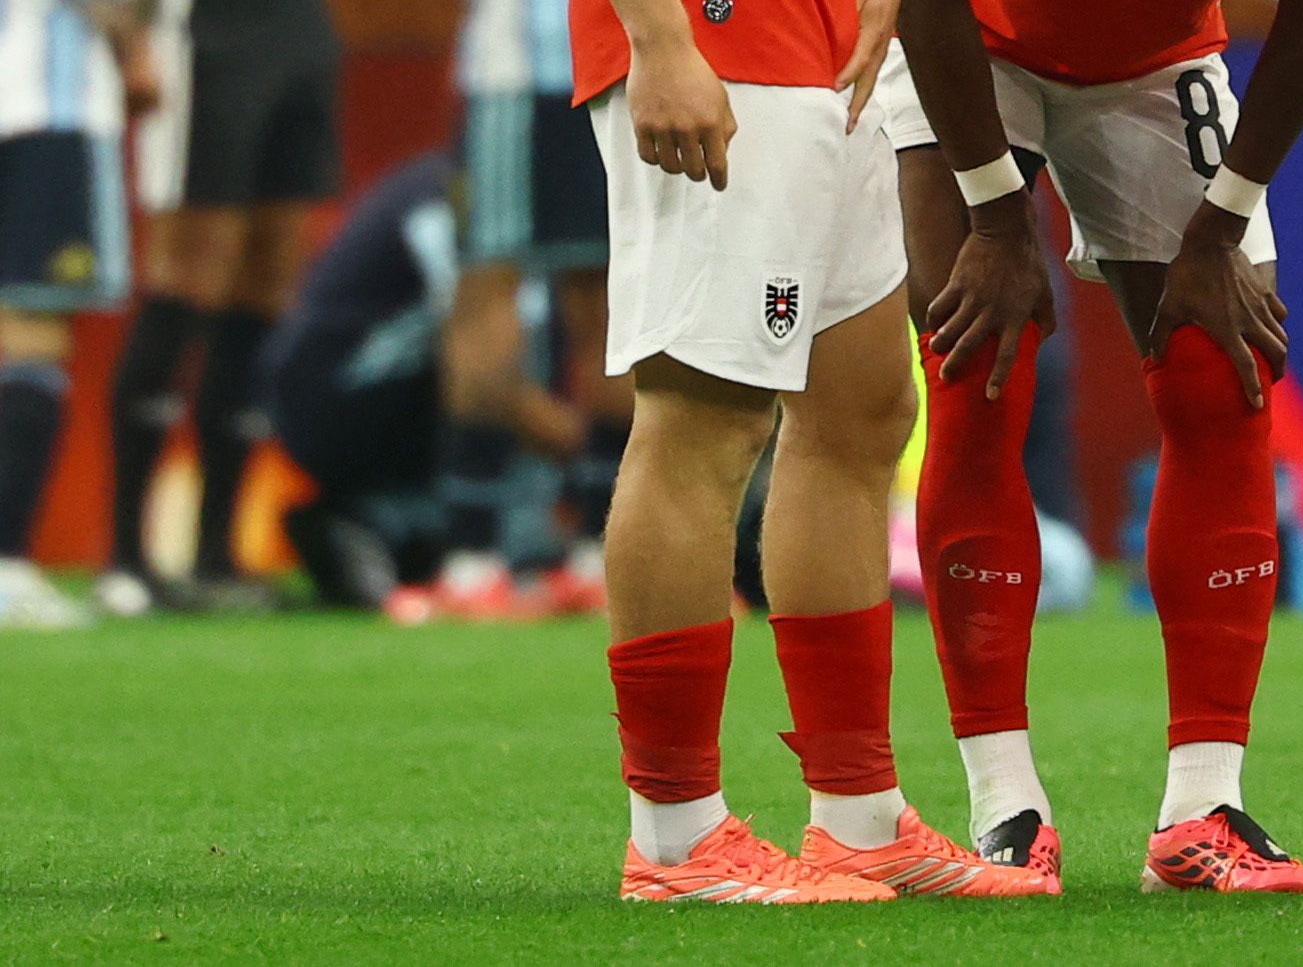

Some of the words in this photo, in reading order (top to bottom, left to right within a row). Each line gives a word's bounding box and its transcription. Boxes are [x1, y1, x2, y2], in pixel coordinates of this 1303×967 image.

[1175, 69, 1228, 180] 8
[948, 563, 1022, 585] ÖFB
[1207, 560, 1275, 589] ÖFB
